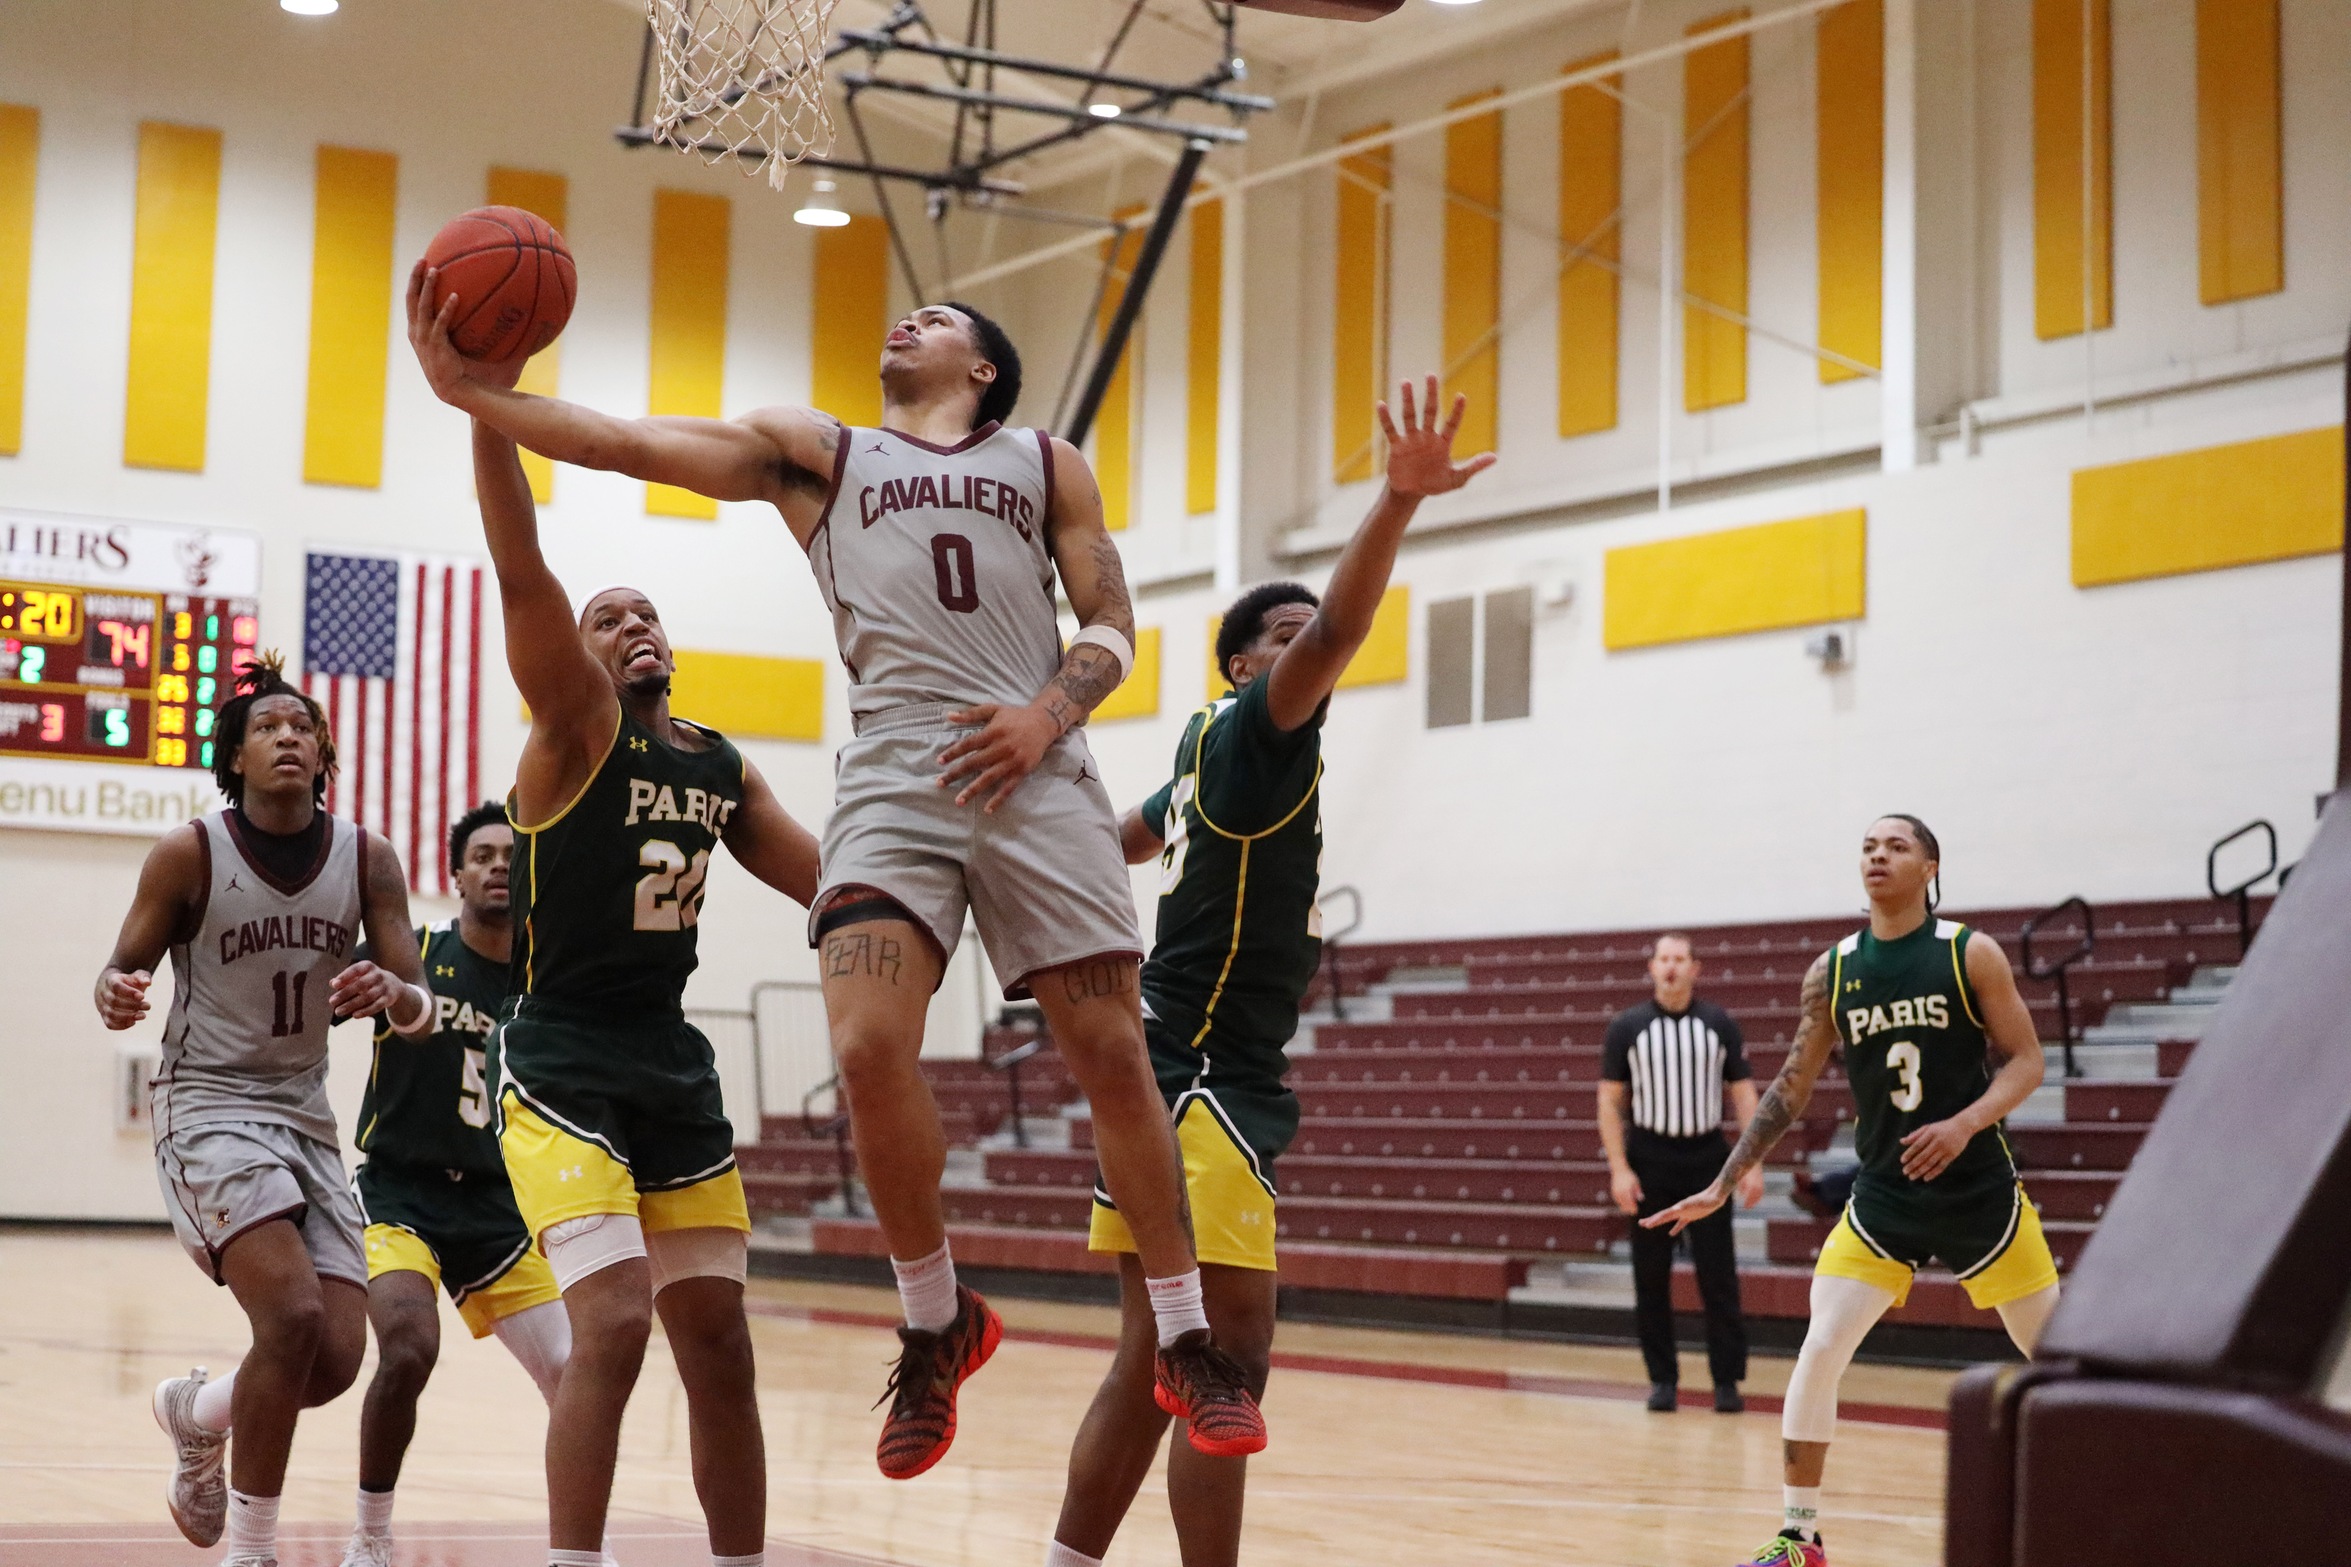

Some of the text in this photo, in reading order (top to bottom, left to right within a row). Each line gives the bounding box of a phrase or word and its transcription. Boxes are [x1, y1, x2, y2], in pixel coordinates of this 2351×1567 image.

[859, 474, 1034, 543] CAVALIERS
[0, 526, 128, 570] LIERS
[931, 533, 980, 614] 0
[20, 646, 45, 685] 2
[98, 620, 149, 668] 74
[40, 703, 65, 742] 3
[105, 708, 130, 747] 5
[97, 779, 213, 820] Bank
[625, 778, 737, 838] PARIS
[220, 915, 348, 965] CAVALIERS
[826, 933, 903, 986] FEAR
[271, 971, 308, 1037] 11
[432, 995, 498, 1043] PAR
[1846, 994, 1949, 1045] PARIS
[458, 1047, 491, 1129] 5
[1886, 1041, 1923, 1112] 3
